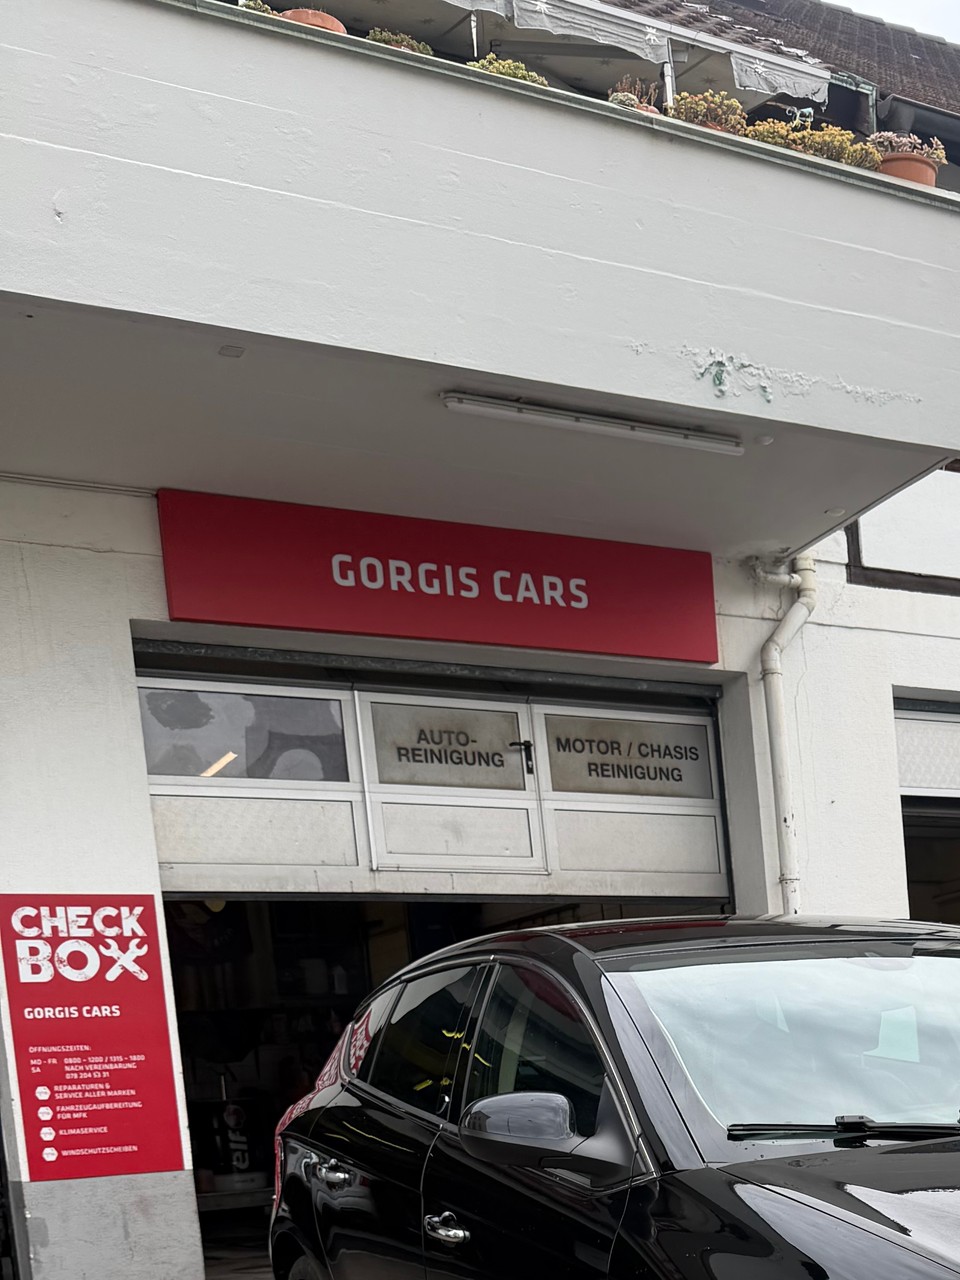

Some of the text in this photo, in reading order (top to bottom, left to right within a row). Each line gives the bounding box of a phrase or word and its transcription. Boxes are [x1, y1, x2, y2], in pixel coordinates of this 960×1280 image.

[331, 553, 589, 609] GORGIS CARS
[416, 729, 478, 748] AUTO-
[555, 737, 700, 761] MOTOR / CHASIS
[396, 747, 505, 768] REINIGUNG
[587, 762, 684, 782] REINIGUNG
[11, 906, 148, 938] CHECK
[15, 938, 149, 983] BOX
[24, 1005, 121, 1019] GORGIS CARS
[59, 1126, 108, 1135] KLIMASERVICE
